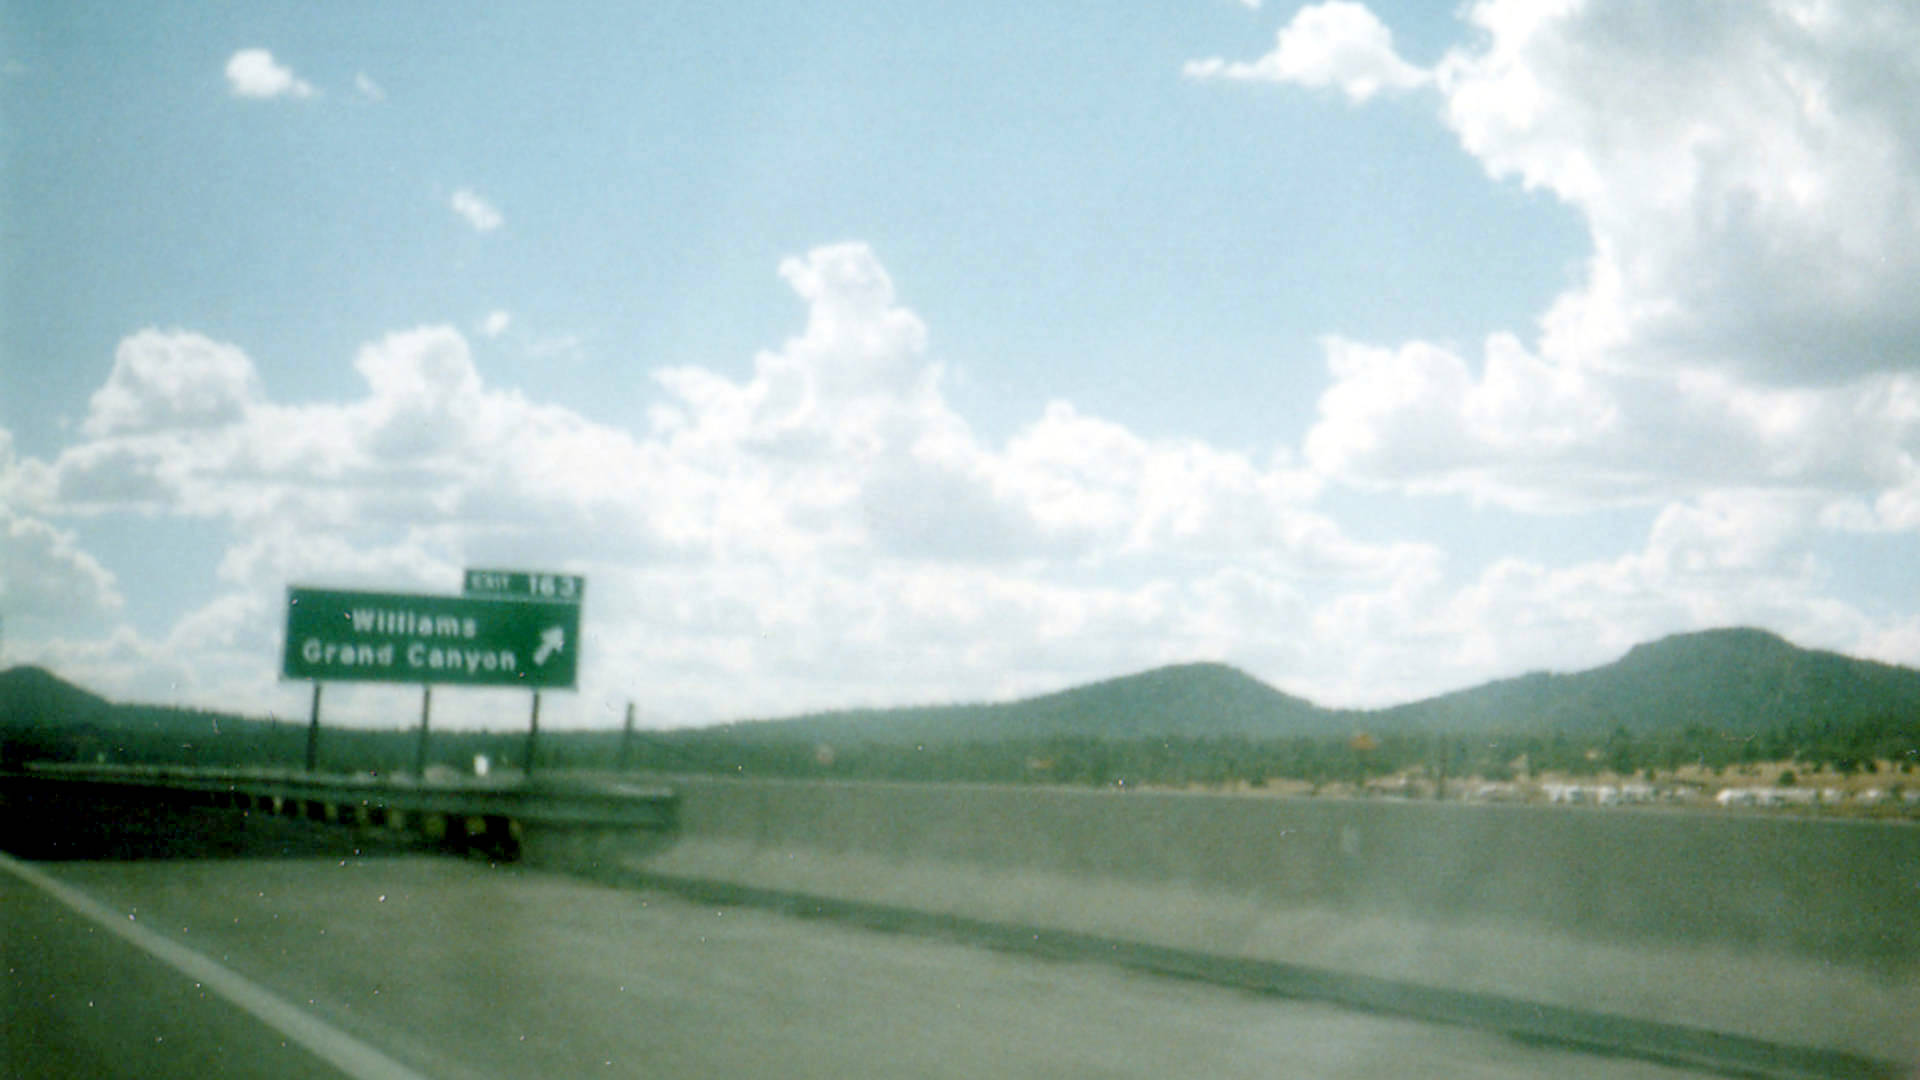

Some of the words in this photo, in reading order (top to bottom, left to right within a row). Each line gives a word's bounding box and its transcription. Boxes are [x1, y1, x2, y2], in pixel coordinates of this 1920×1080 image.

[471, 574, 510, 590] EXIT
[529, 576, 576, 597] 163
[352, 608, 477, 639] Williams
[302, 638, 395, 666] Grand
[407, 643, 517, 676] Canyon
